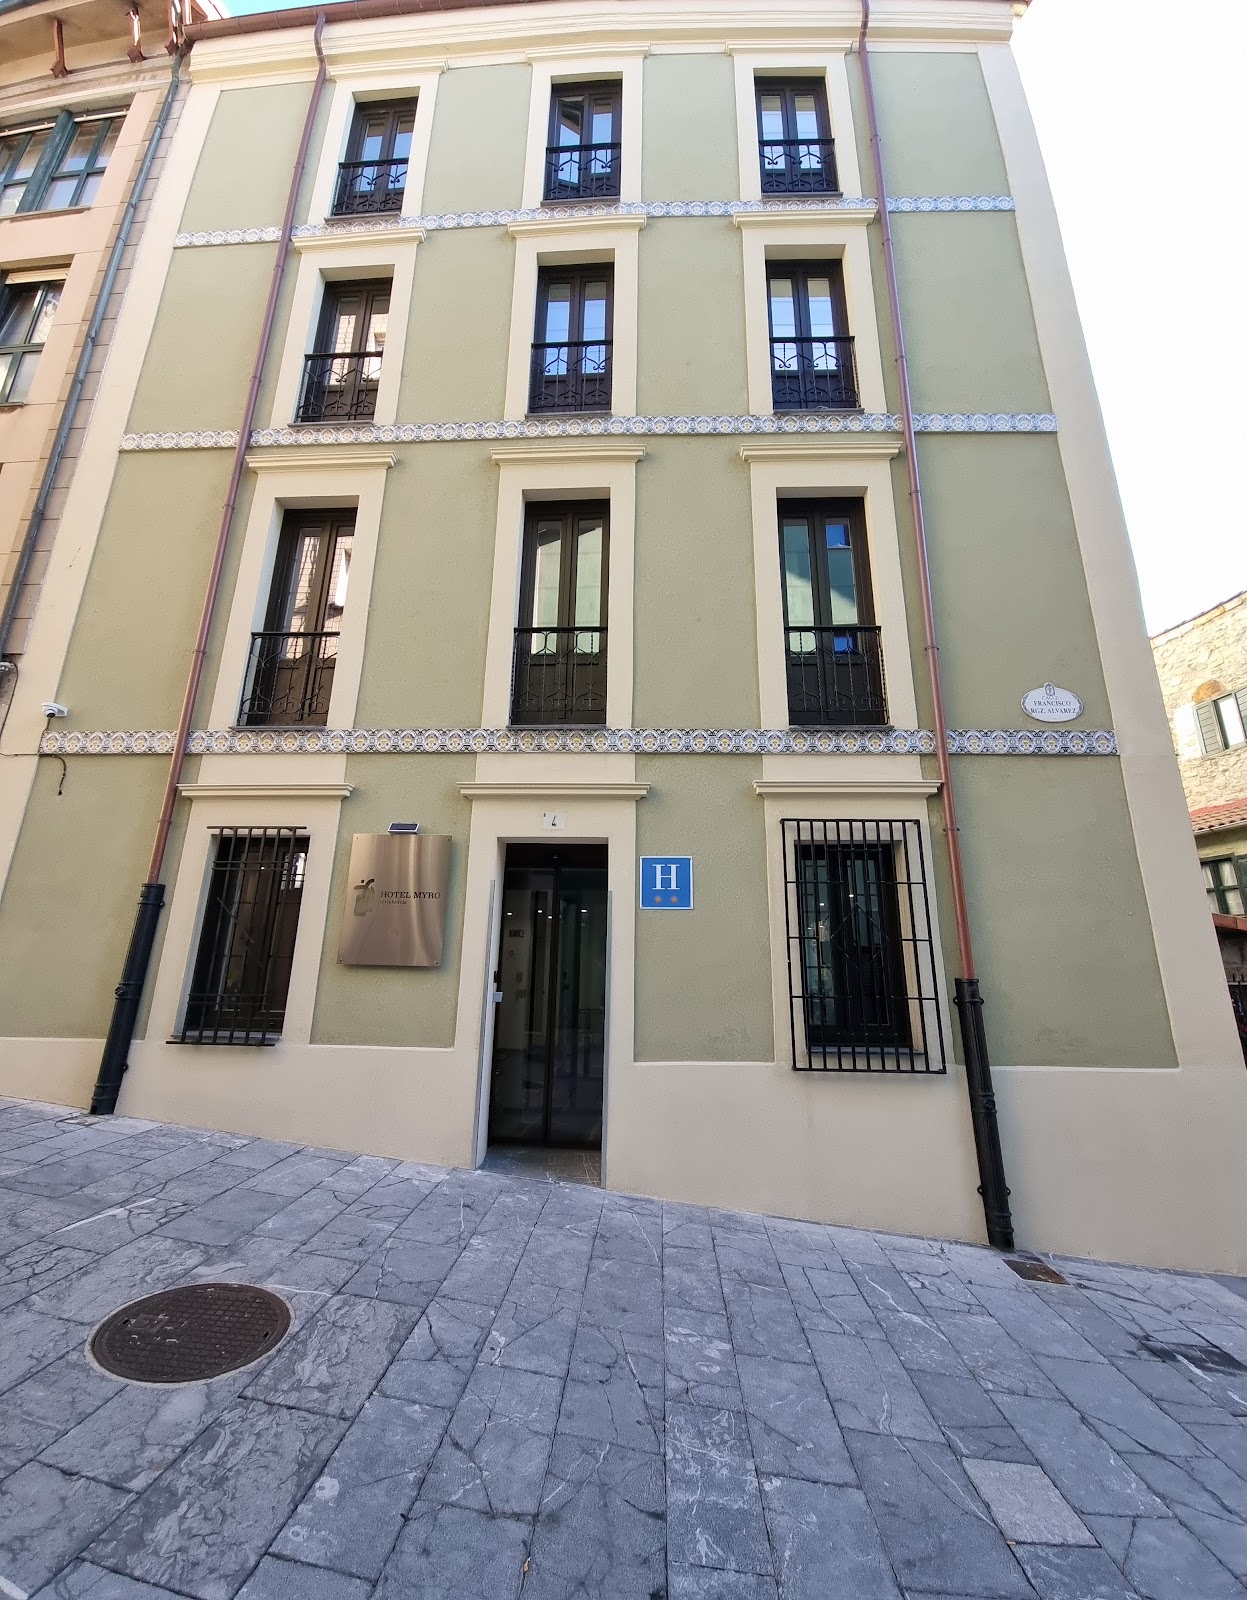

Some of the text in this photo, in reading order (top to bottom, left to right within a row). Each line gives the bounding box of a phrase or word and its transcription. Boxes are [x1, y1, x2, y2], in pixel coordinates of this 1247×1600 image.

[652, 863, 681, 890] H
[380, 890, 441, 899] HOTEL MYRO
